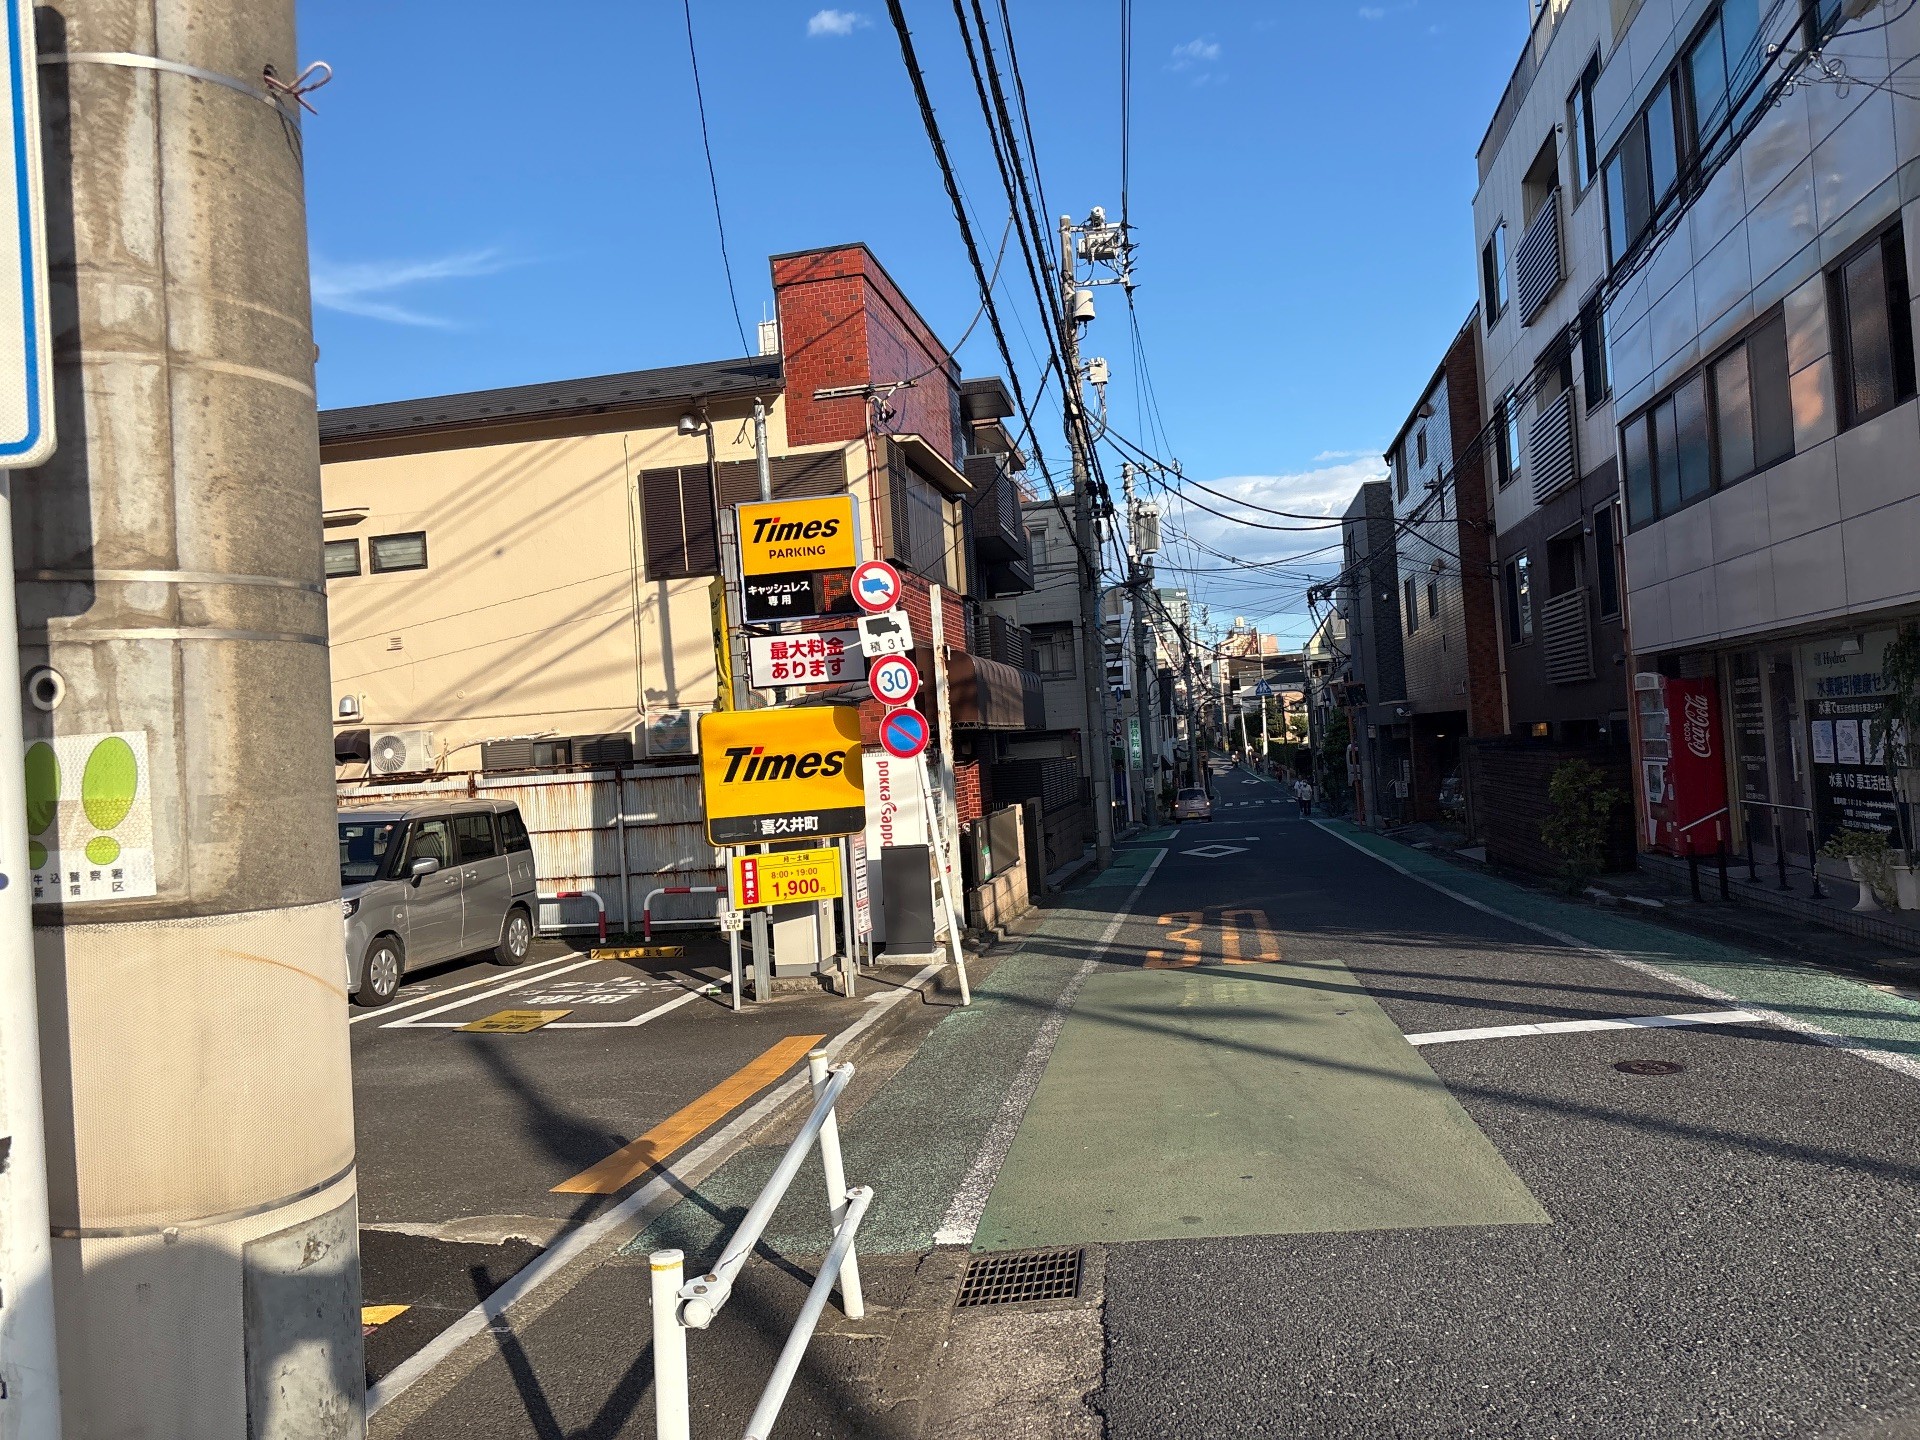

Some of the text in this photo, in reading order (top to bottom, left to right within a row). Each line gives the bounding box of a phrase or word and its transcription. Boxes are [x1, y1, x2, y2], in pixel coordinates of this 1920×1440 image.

[753, 517, 840, 543] Times
[769, 545, 826, 559] PARKING
[748, 581, 811, 596] キャッシュレス
[768, 594, 792, 606] 専用
[822, 573, 850, 612] P
[770, 636, 845, 661] 最大料金
[771, 656, 846, 680] あります
[880, 668, 909, 693] 30
[722, 746, 846, 785] Times
[1843, 773, 1856, 788] VS
[760, 815, 819, 836] 喜久井町
[33, 868, 123, 886] 牛込警察署
[1143, 909, 1282, 970] 30
